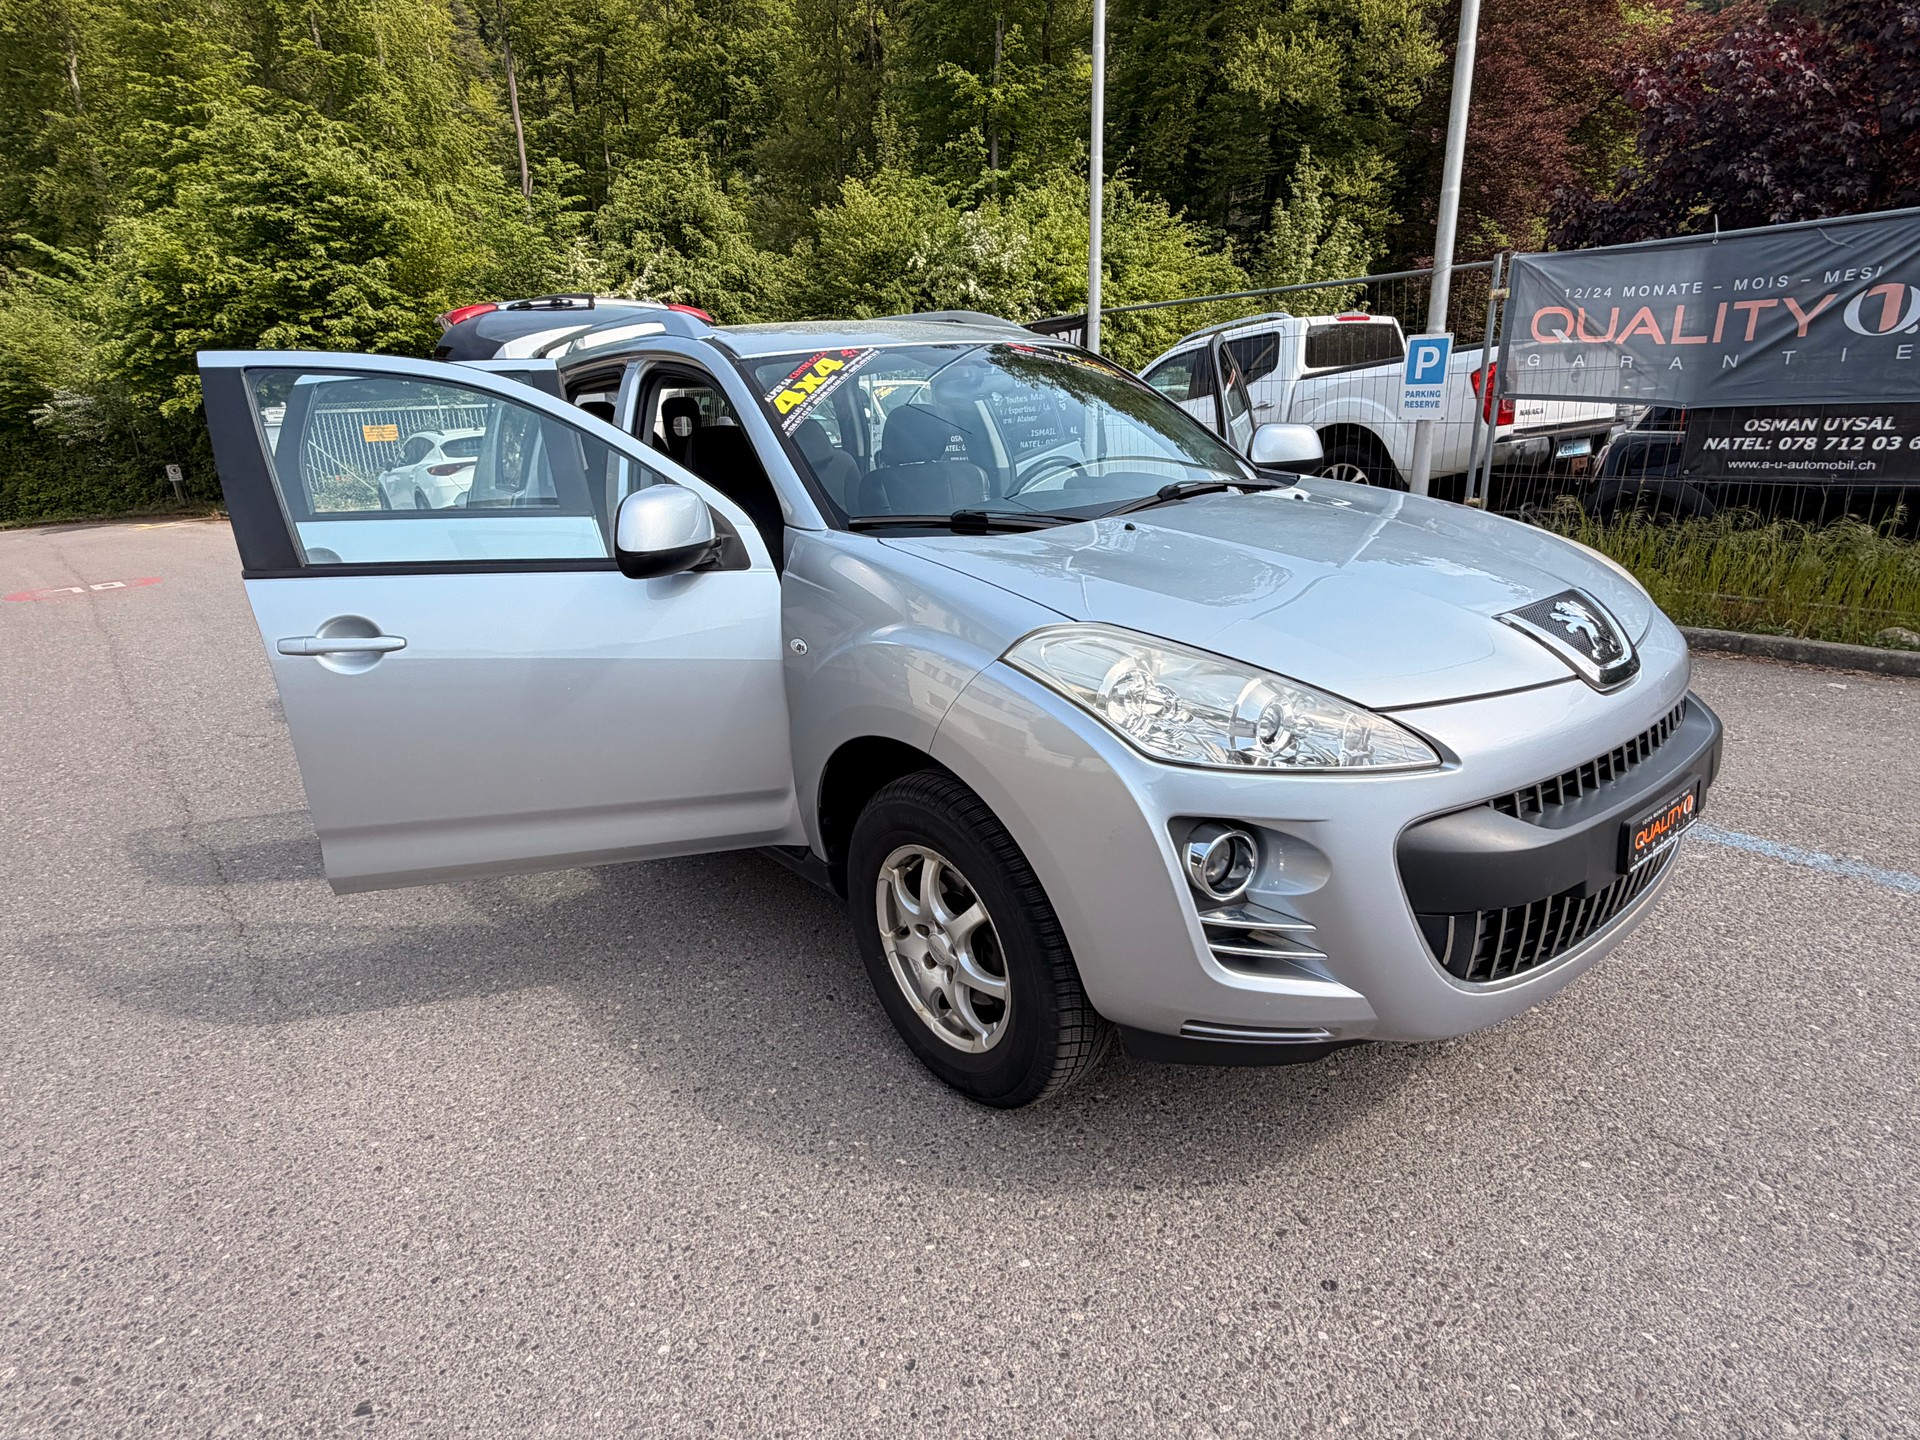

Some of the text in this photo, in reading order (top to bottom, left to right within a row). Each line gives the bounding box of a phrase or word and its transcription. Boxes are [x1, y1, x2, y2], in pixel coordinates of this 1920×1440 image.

[1564, 287, 1612, 298] 12/24
[1622, 282, 1703, 298] MONATE
[1734, 275, 1789, 291] MOIS
[1824, 266, 1883, 284] MESI
[1531, 293, 1839, 345] QUALITY
[1415, 346, 1440, 380] P
[1527, 344, 1914, 371] GARANTIE
[1404, 400, 1440, 408] RESERVE
[1405, 390, 1441, 398] PARKING
[1744, 416, 1896, 432] OSMAN UYSAL
[1703, 437, 1773, 450] NATEL:
[1778, 437, 1818, 450] 078
[1823, 437, 1866, 450] 712
[1872, 436, 1903, 450] 03
[1727, 460, 1876, 471] www.a-u-automobil.ch
[1635, 802, 1684, 849] QUALITY
